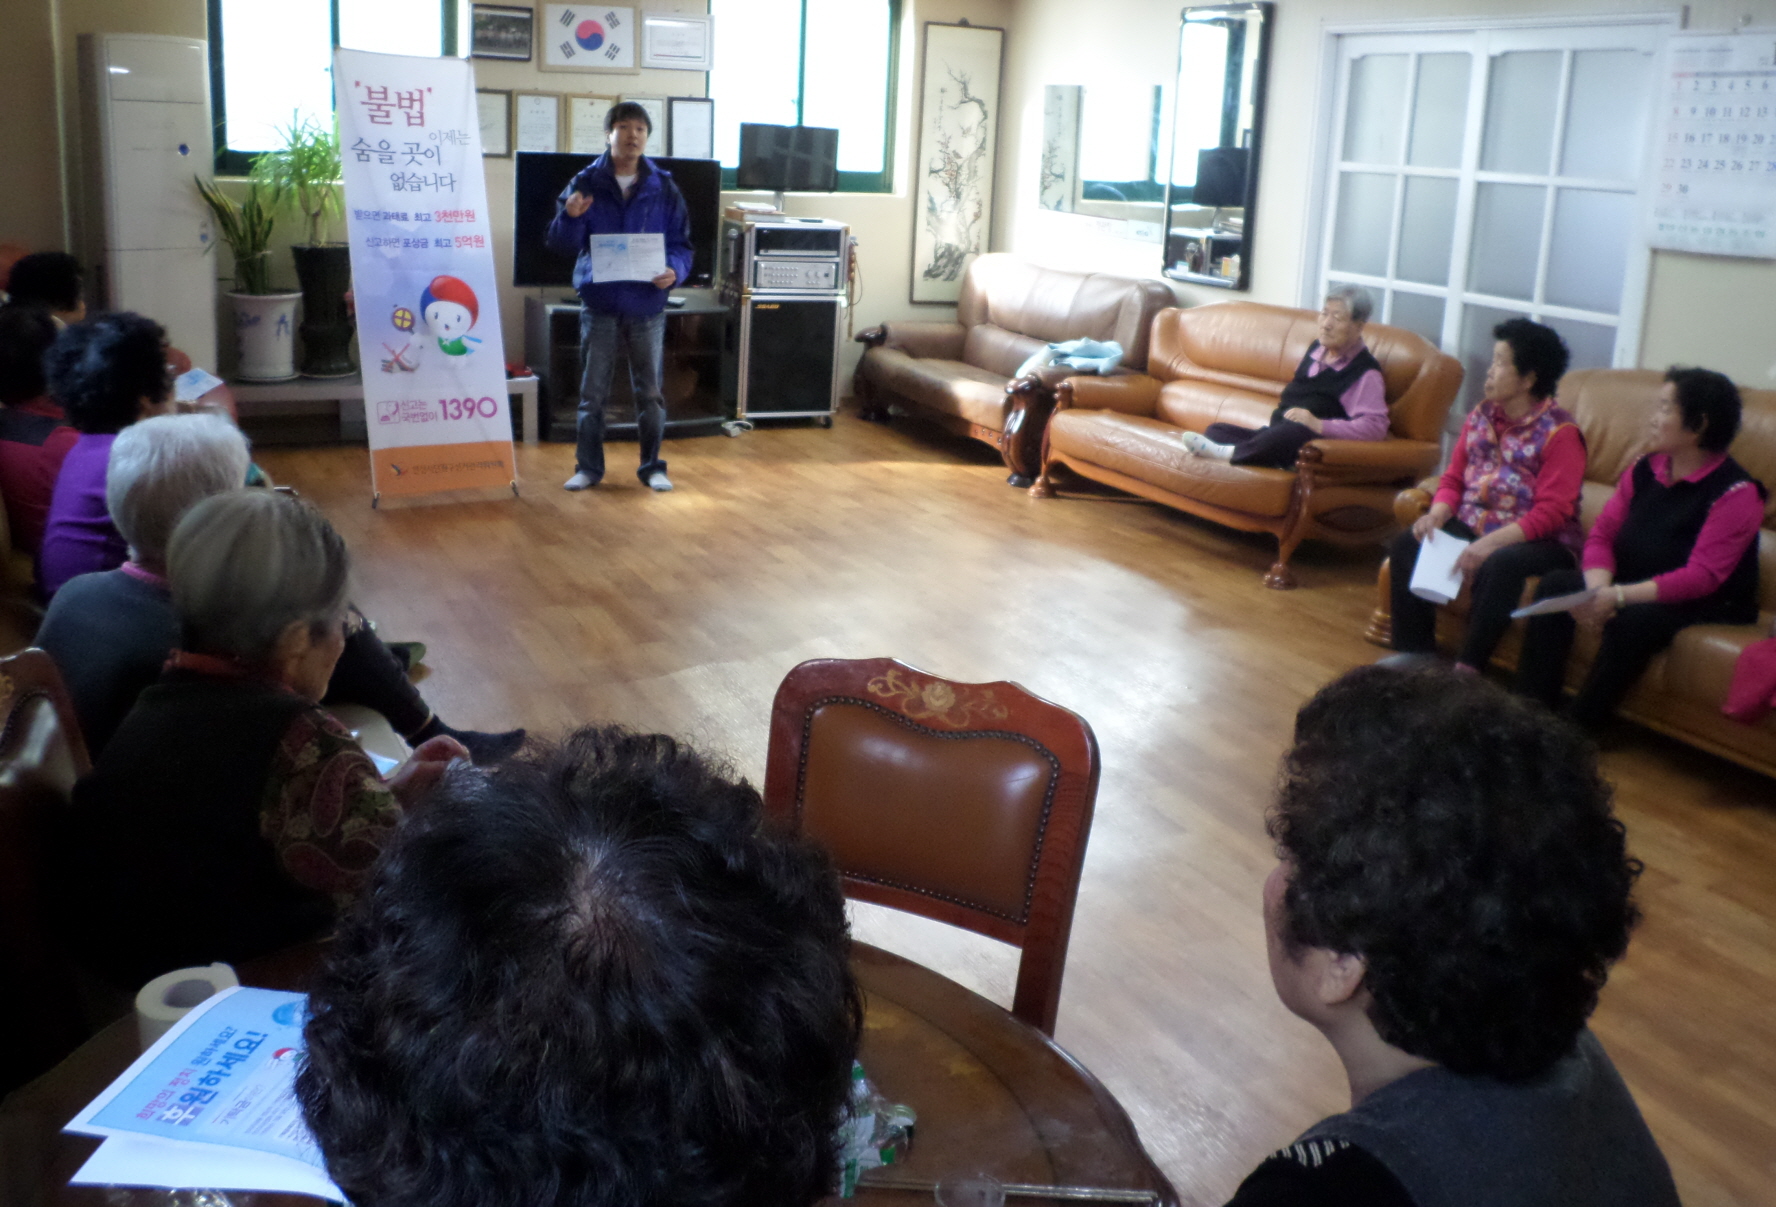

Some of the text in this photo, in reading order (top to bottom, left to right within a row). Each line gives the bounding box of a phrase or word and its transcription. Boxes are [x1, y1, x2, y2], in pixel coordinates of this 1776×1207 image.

[1693, 80, 1700, 91] 2
[1710, 80, 1718, 91] 3
[1727, 80, 1735, 91] 4
[1744, 80, 1752, 91] 5
[1762, 80, 1769, 91] 6
[1690, 107, 1698, 117] 9
[1705, 107, 1716, 117] 10
[1723, 107, 1732, 118] 11
[1740, 107, 1751, 118] 12
[1757, 106, 1768, 118] 13
[429, 129, 471, 147] 이제는
[1684, 133, 1695, 143] 16
[1701, 133, 1713, 143] 17
[1718, 133, 1730, 144] 18
[1736, 133, 1747, 144] 19
[1752, 133, 1764, 145] 20
[351, 136, 442, 167] 숨을 곳이
[1680, 158, 1692, 169] 23
[1697, 159, 1709, 170] 24
[1714, 159, 1726, 170] 25
[1731, 160, 1743, 171] 26
[1748, 161, 1761, 172] 27
[390, 171, 457, 193] 없습니다
[354, 209, 476, 224] 받으면 과태료 최고 3천만원
[366, 234, 485, 249] 신고하면 포상금 최고 5억원
[401, 399, 428, 411] 신고는
[438, 396, 498, 421] 1390
[401, 411, 438, 423] 국번없이
[136, 1025, 238, 1121] 희망의 정치 원하세요?
[160, 1030, 269, 1127] 후원하세요!
